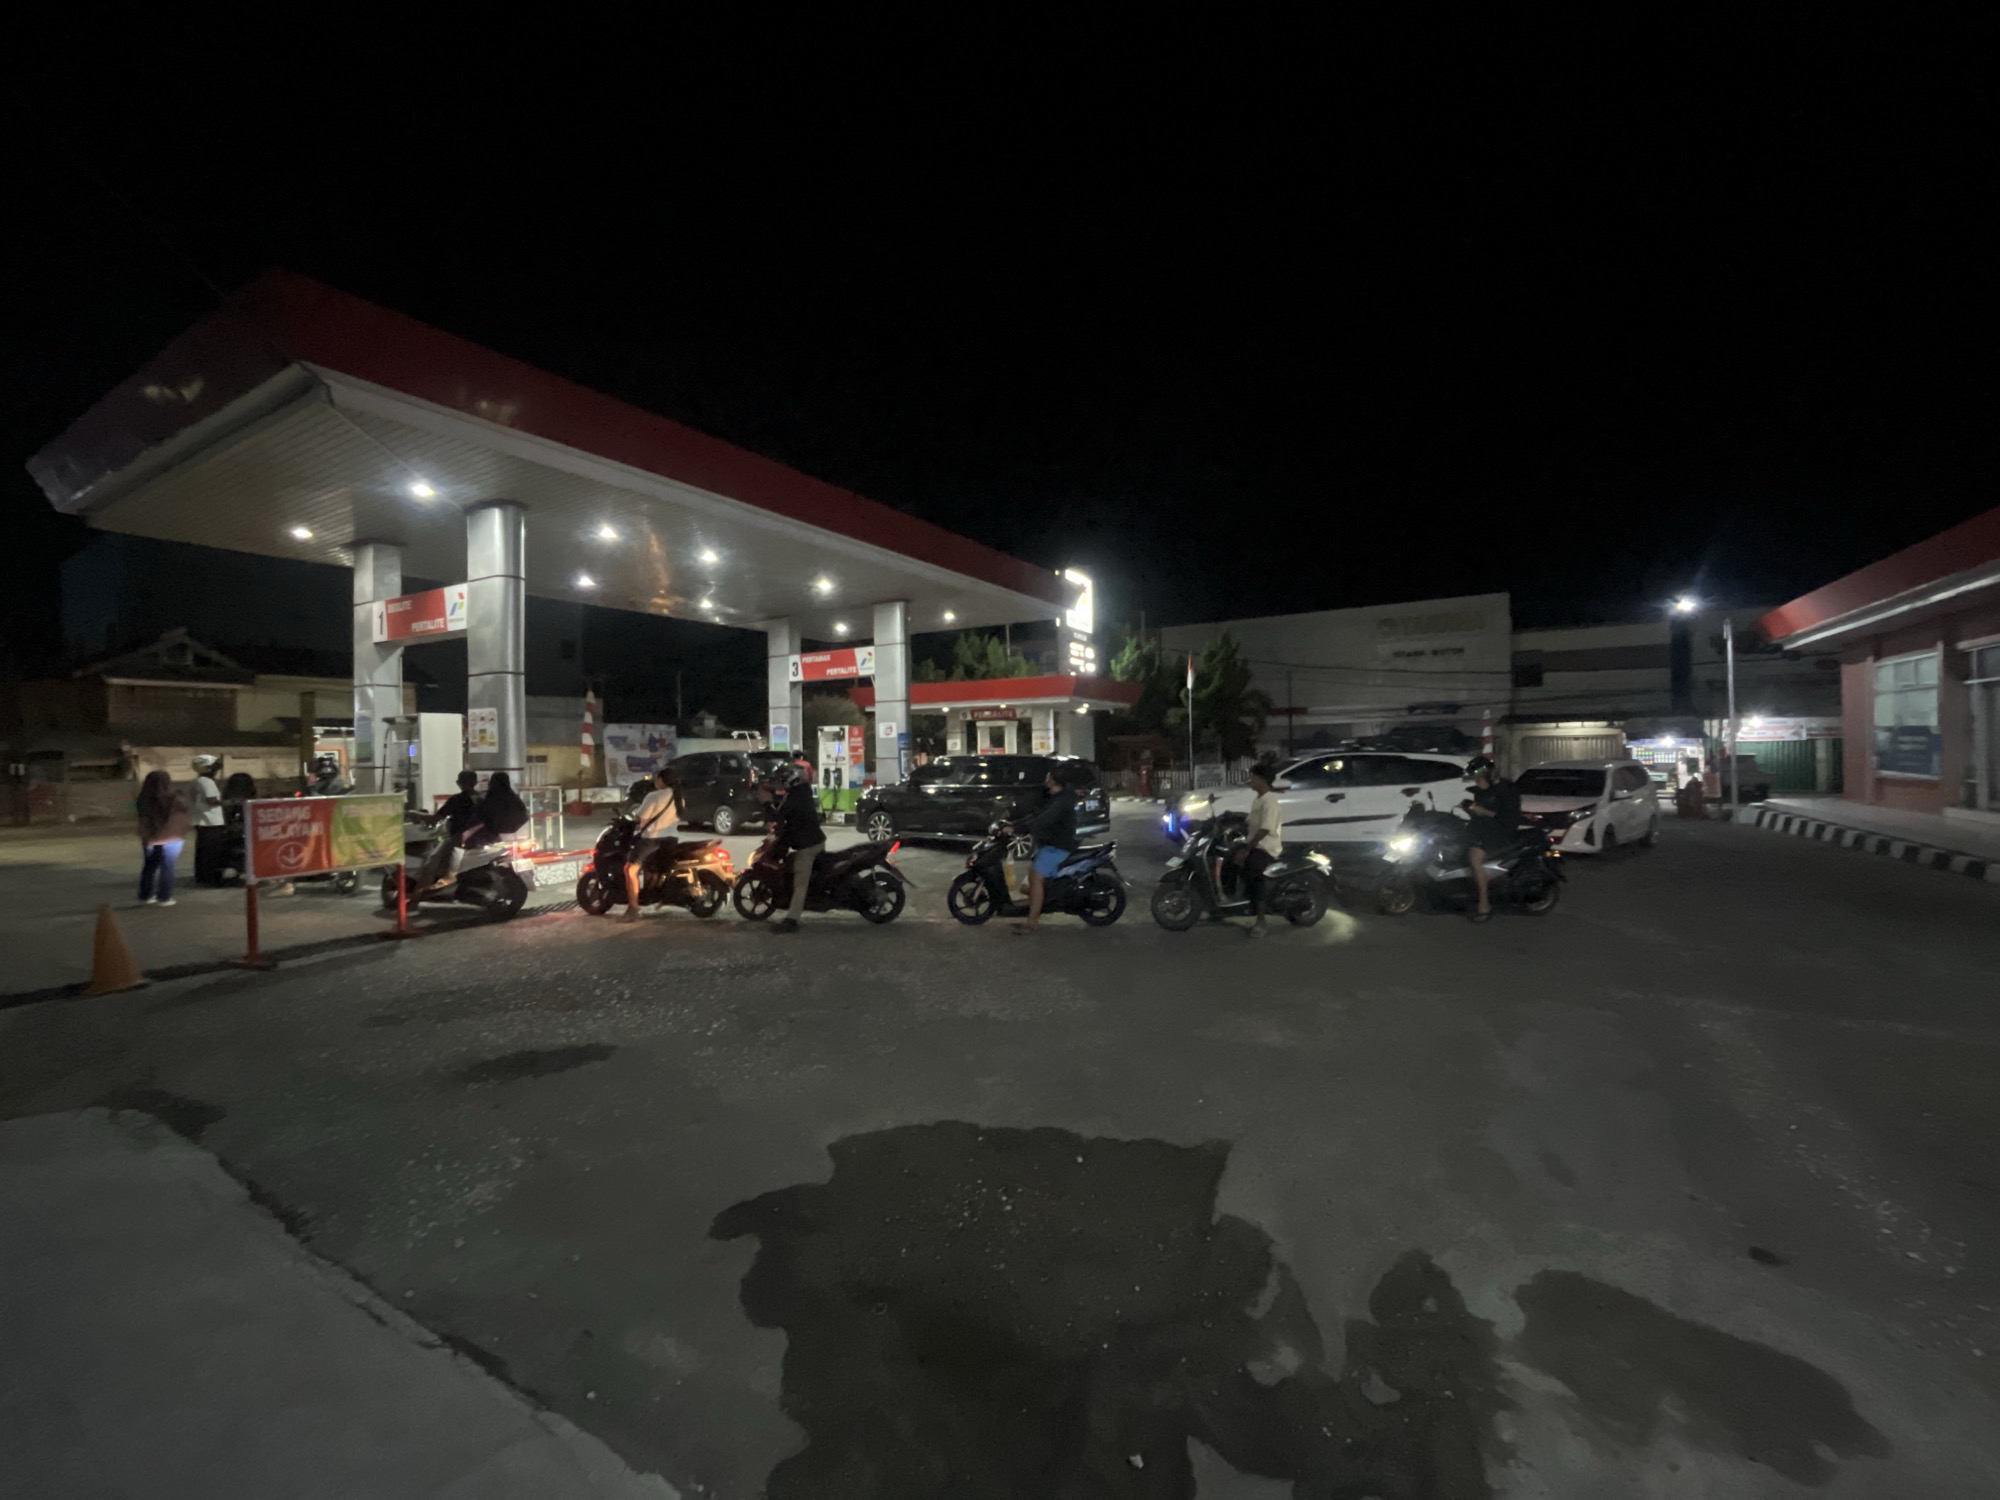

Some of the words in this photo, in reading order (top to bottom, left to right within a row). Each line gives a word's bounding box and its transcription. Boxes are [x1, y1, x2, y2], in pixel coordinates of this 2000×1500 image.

[379, 611, 384, 635] 1
[411, 618, 445, 632] PERTALITE
[792, 662, 799, 677] 3
[826, 666, 857, 676] PERTALITE
[257, 806, 311, 822] SEDANG
[258, 821, 324, 840] MELAYANI
